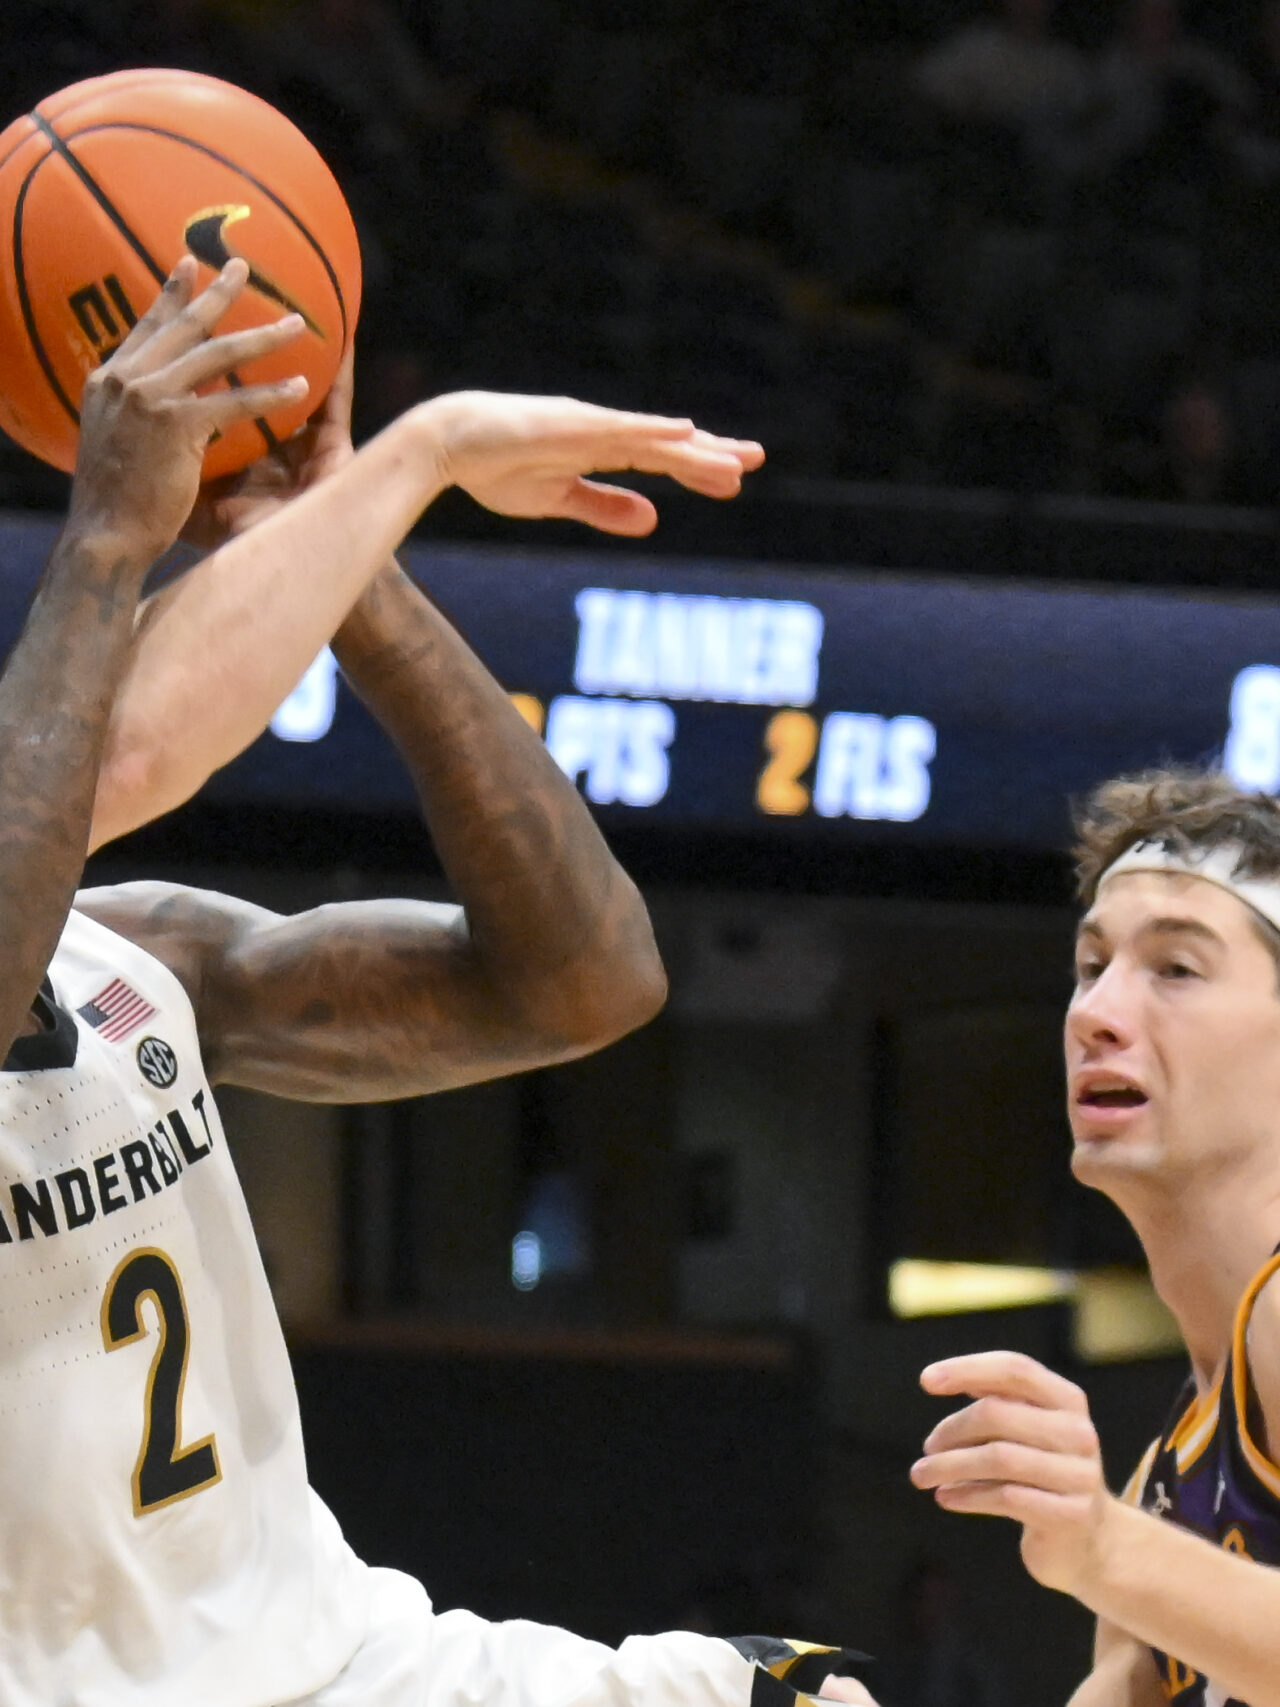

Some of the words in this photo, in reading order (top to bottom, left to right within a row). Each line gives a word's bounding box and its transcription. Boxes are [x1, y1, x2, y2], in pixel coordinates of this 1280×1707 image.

[574, 587, 824, 708] TANNER
[546, 694, 676, 807] PTS
[757, 709, 819, 816] 2
[813, 711, 937, 823] FLS
[137, 1036, 179, 1090] SEC
[100, 1246, 223, 1517] 2
